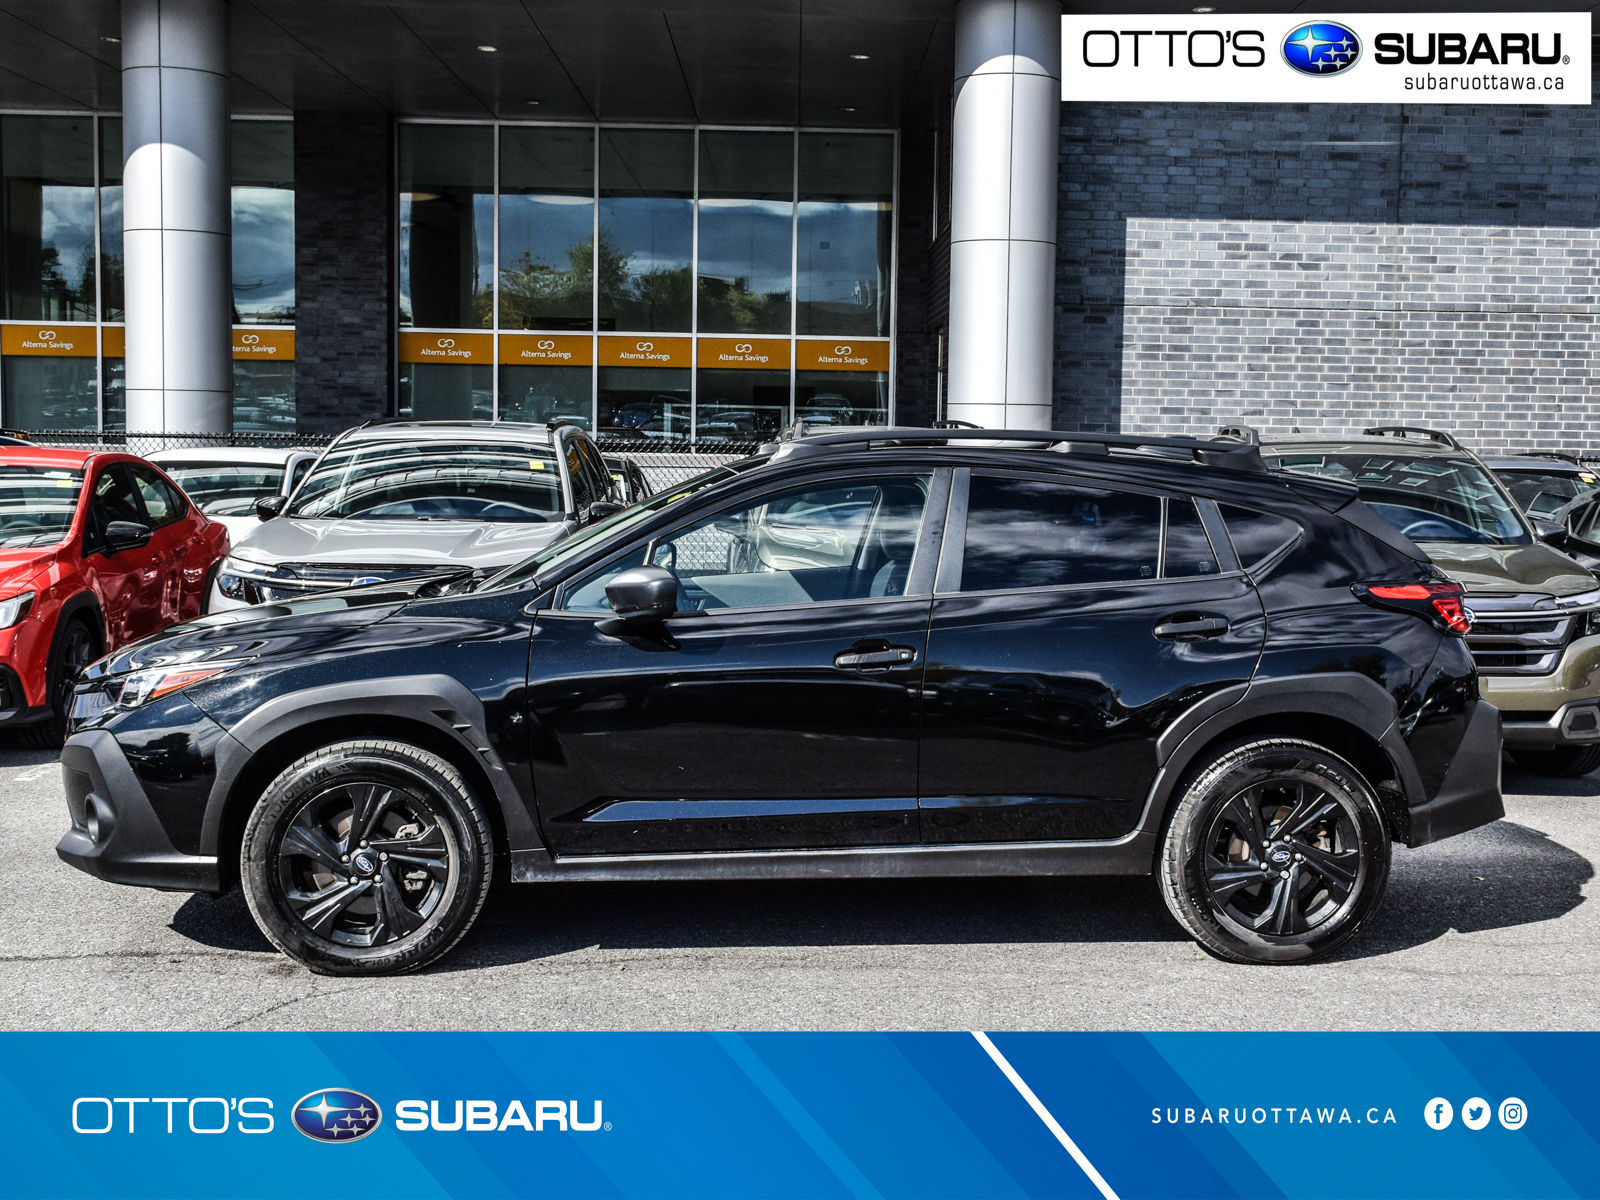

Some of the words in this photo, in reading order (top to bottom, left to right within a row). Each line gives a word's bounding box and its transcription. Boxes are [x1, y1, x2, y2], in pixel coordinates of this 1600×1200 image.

[48, 341, 74, 350] Savings
[251, 345, 277, 354] Savings
[447, 349, 471, 357] Savings
[547, 351, 571, 359] Savings
[646, 353, 670, 361] Savings
[745, 354, 769, 362] Savings
[844, 356, 868, 364] Savings
[269, 766, 332, 820] YOKOHAMA
